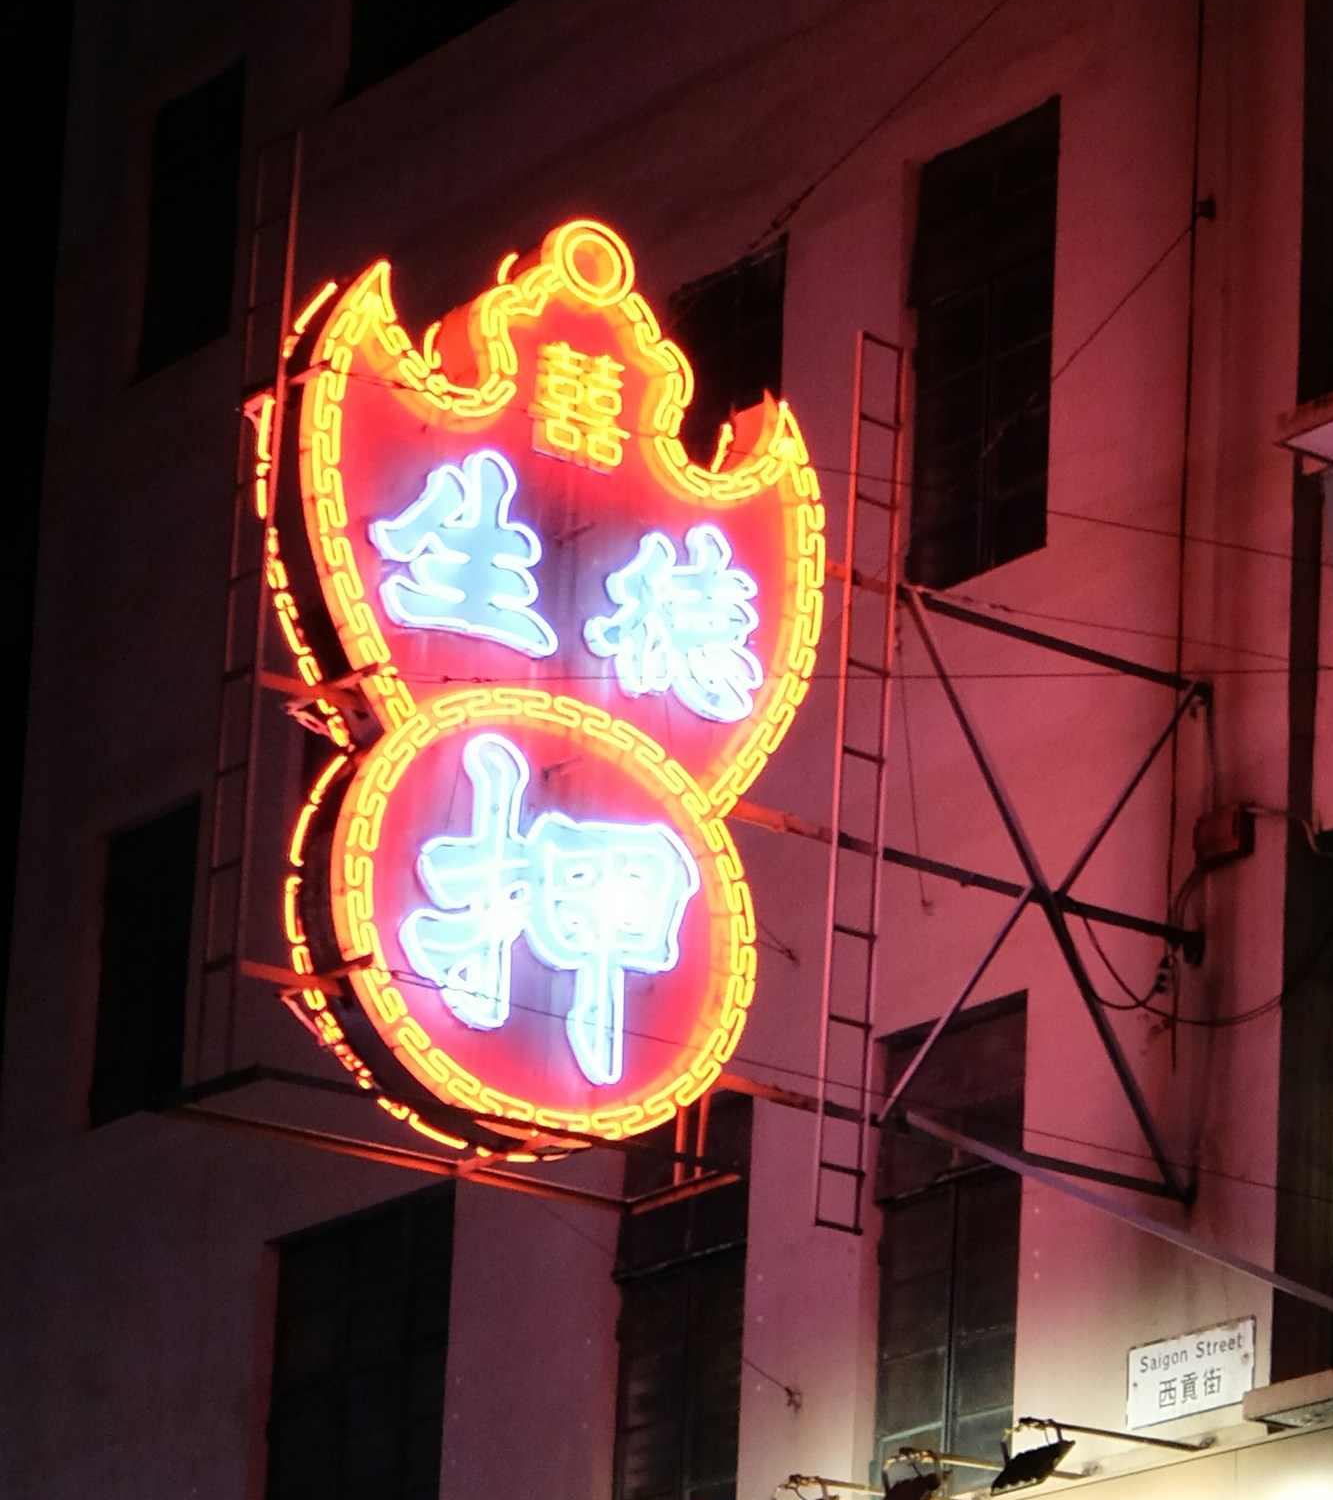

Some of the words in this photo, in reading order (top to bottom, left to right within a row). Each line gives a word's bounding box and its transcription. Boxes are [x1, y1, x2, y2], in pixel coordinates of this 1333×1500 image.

[400, 734, 699, 1085] 押
[1140, 1350, 1188, 1373] Saigon
[1196, 1333, 1243, 1359] Street
[1159, 1368, 1221, 1409] 西貢街
